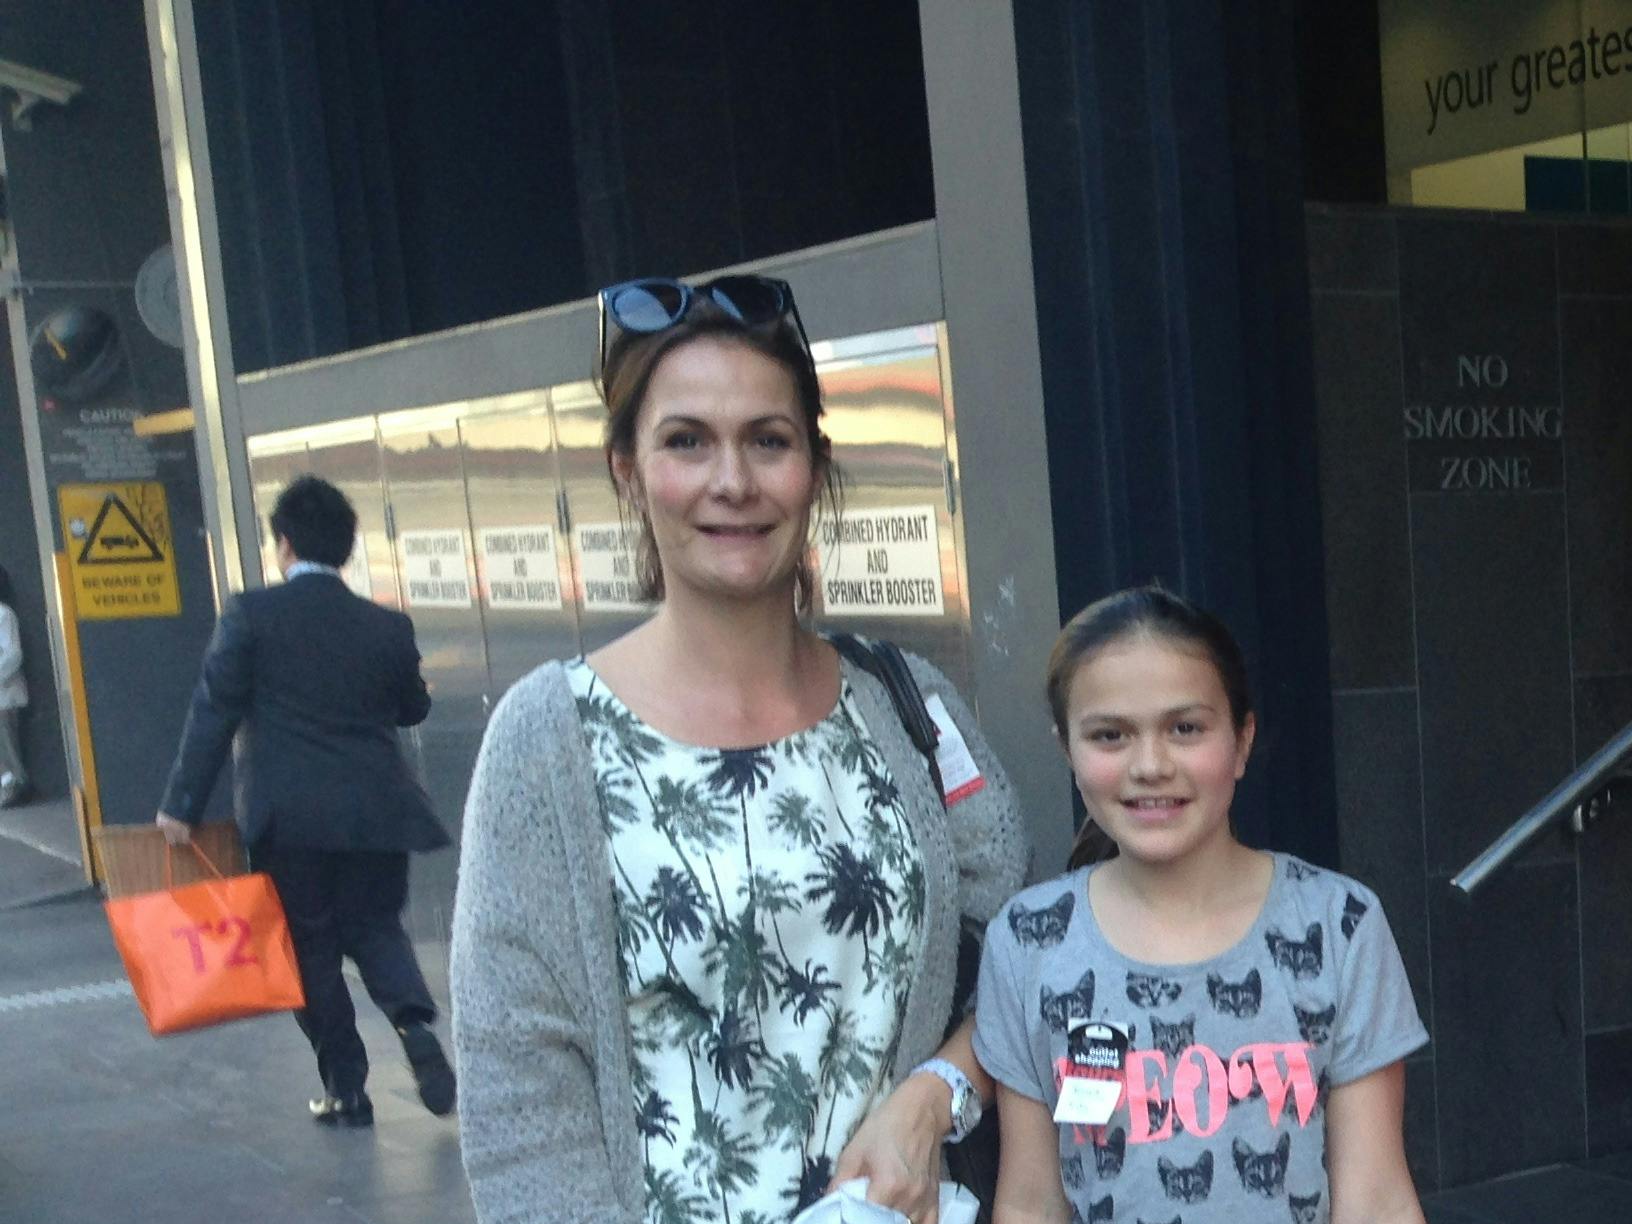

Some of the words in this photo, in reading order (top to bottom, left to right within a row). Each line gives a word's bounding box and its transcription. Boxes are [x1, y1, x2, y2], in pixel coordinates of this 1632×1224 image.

[1424, 59, 1498, 136] your
[1458, 354, 1509, 388] NO
[1403, 405, 1563, 440] SMOKING
[1441, 456, 1533, 489] ZONE
[822, 518, 874, 545] COMBINED
[875, 515, 928, 543] HYDRANT
[866, 548, 889, 574] AND
[82, 574, 143, 590] BEWARE
[146, 573, 164, 588] OF
[827, 579, 885, 606] SPRINKLER
[886, 579, 937, 605] BOOSTER
[92, 591, 161, 607] VEHICLES
[171, 915, 259, 975] T2
